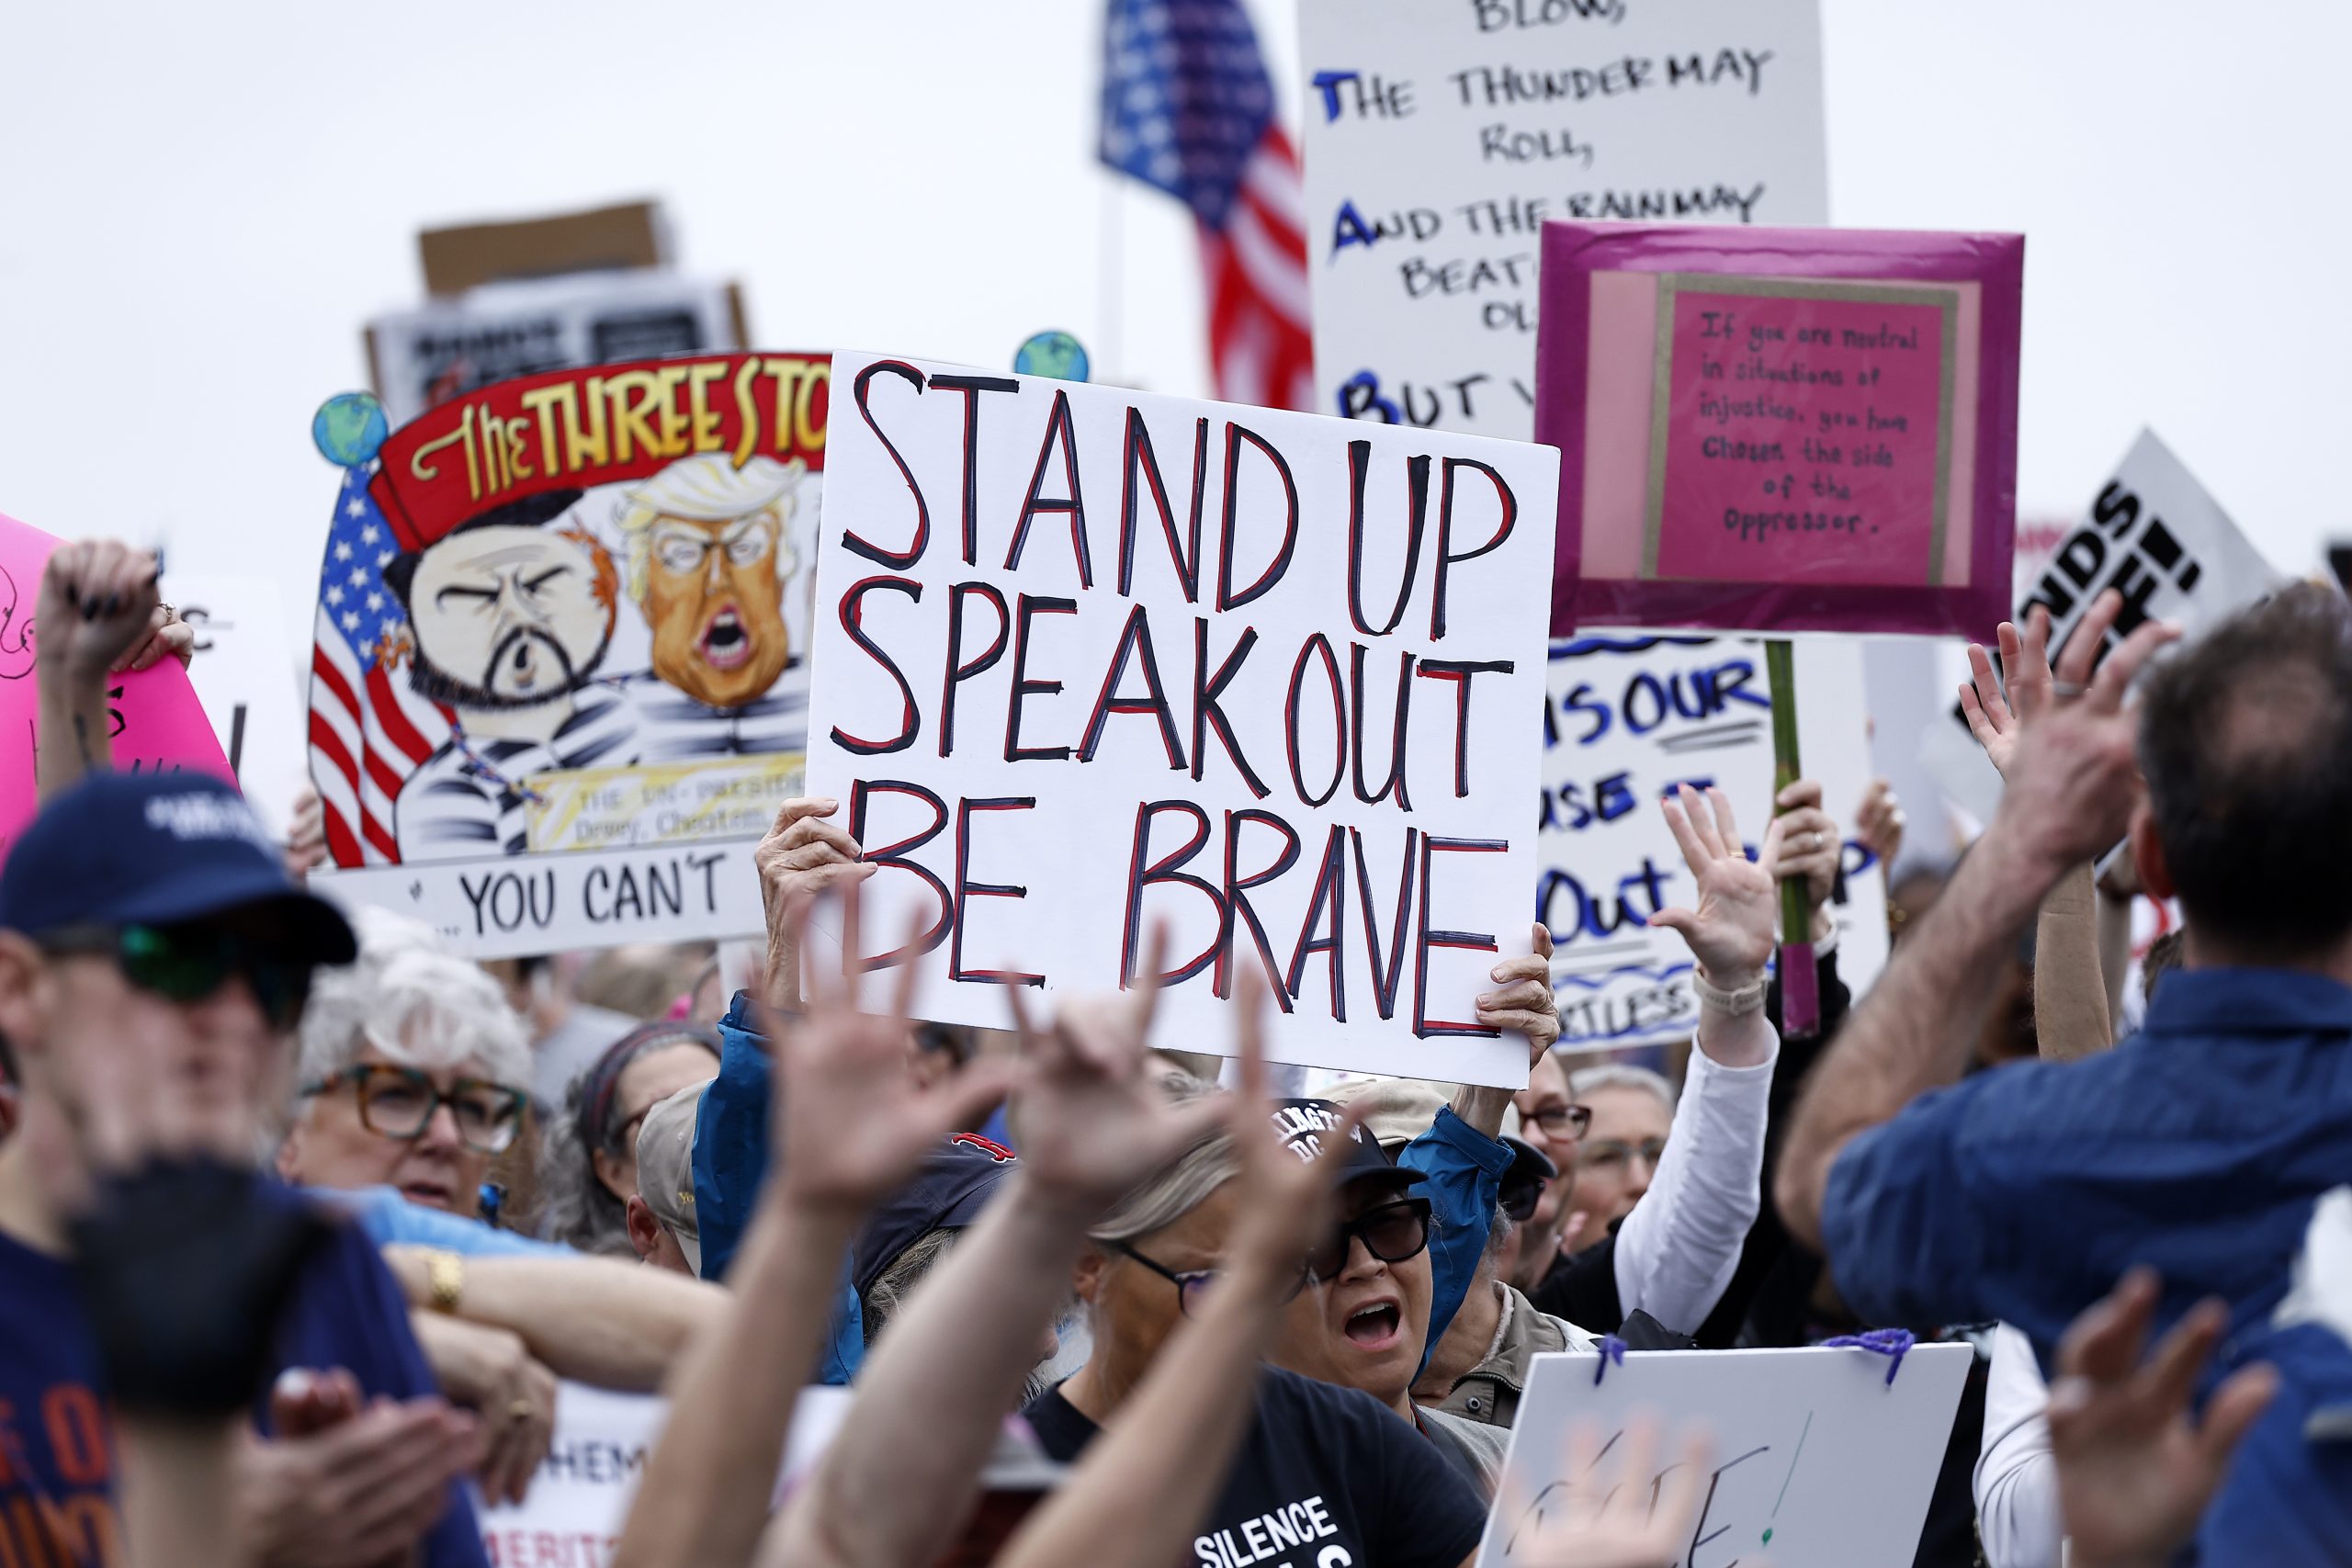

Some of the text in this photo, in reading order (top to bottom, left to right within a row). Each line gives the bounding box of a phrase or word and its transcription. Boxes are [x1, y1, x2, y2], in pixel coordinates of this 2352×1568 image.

[1310, 47, 1774, 124] THE THUNDER MAY
[1479, 123, 1594, 170] ROLL,
[1327, 182, 1764, 266] AND THE RAIN MAY
[1700, 310, 1919, 353] If you are neutral
[1338, 370, 1492, 426] BUT
[1702, 353, 1882, 388] in situations of
[521, 360, 729, 479] THREE
[731, 355, 830, 472] STO
[1799, 437, 1842, 465] the
[1852, 443, 1894, 468] side
[1818, 410, 1859, 434] you
[1866, 407, 1909, 434] have
[841, 359, 1519, 642] STAND UP
[1763, 472, 1852, 501] of the
[2016, 478, 2142, 626] NDS
[830, 574, 1515, 813] SPEAK OUT
[1622, 659, 1771, 737] OUR
[582, 852, 729, 923] CAN'T
[844, 778, 1510, 1040] BE BRAVE
[678, 1191, 695, 1205] Yo
[1193, 1495, 1339, 1568] SILENCE
